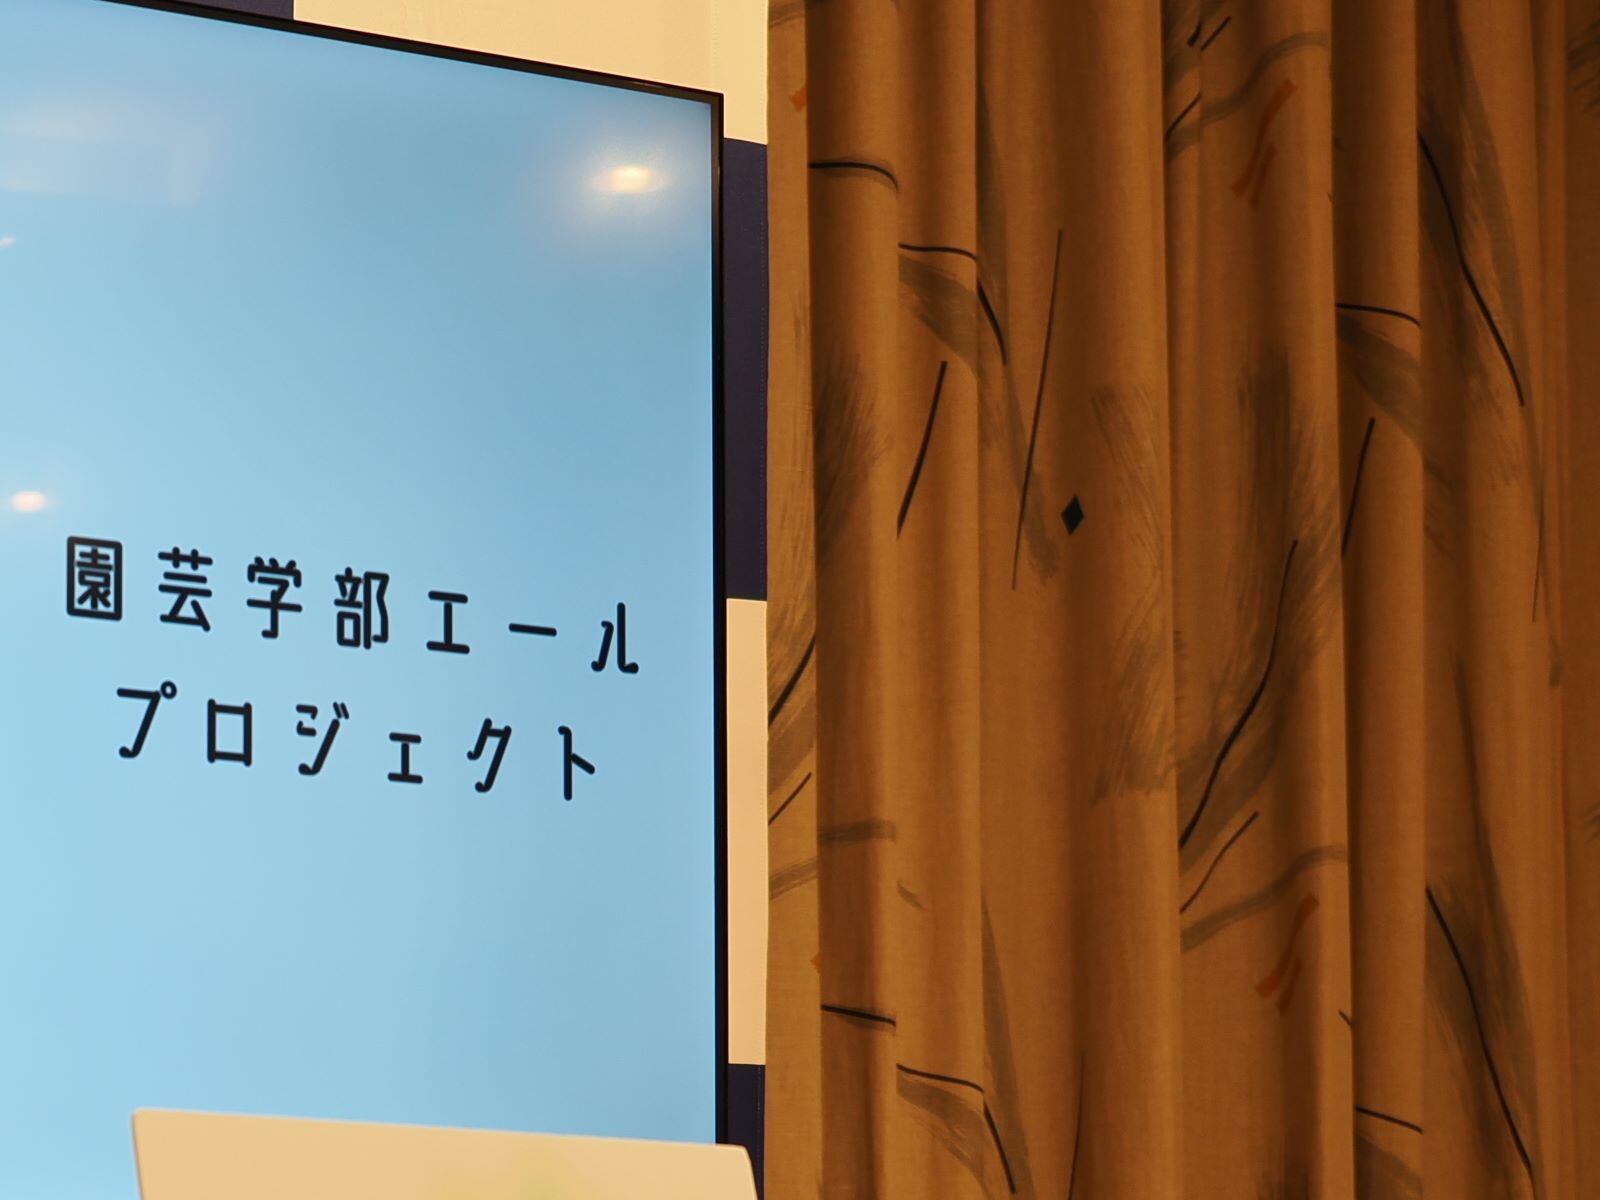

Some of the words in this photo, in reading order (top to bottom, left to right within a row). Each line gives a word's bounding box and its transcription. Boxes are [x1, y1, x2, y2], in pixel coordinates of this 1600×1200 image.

[66, 535, 640, 675] 園芸学部エール
[116, 680, 595, 802] プロジェクト
